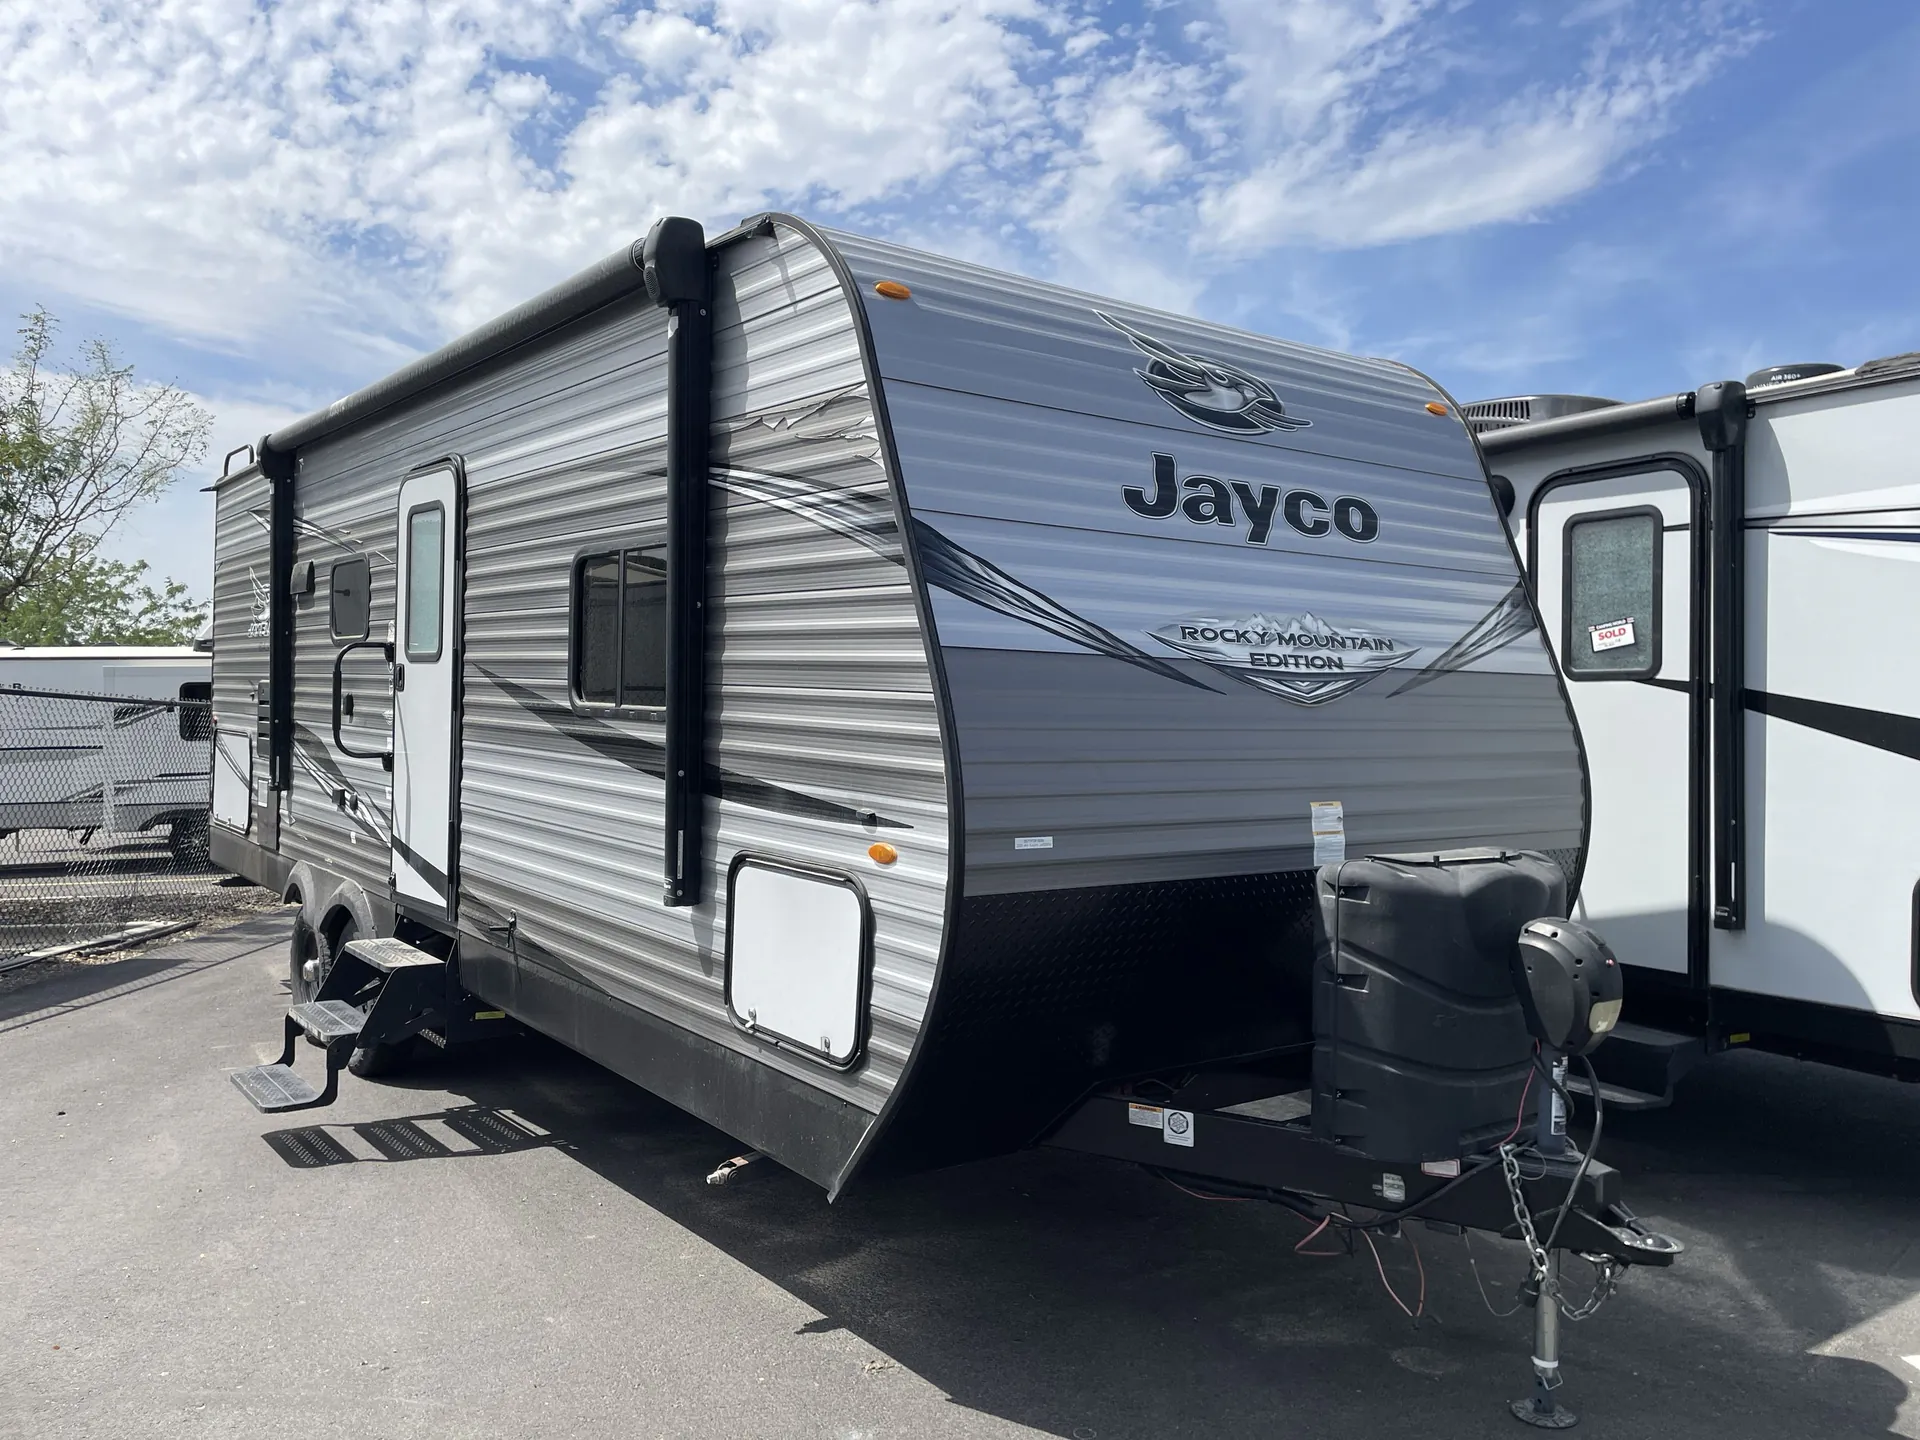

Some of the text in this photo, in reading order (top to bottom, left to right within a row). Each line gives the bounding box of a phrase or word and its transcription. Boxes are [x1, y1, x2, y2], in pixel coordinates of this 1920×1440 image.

[1122, 451, 1380, 545] Jayco
[1180, 625, 1395, 652] ROCKY MOUNTAIN
[1598, 628, 1626, 641] SOLD
[1249, 652, 1345, 671] EDITION
